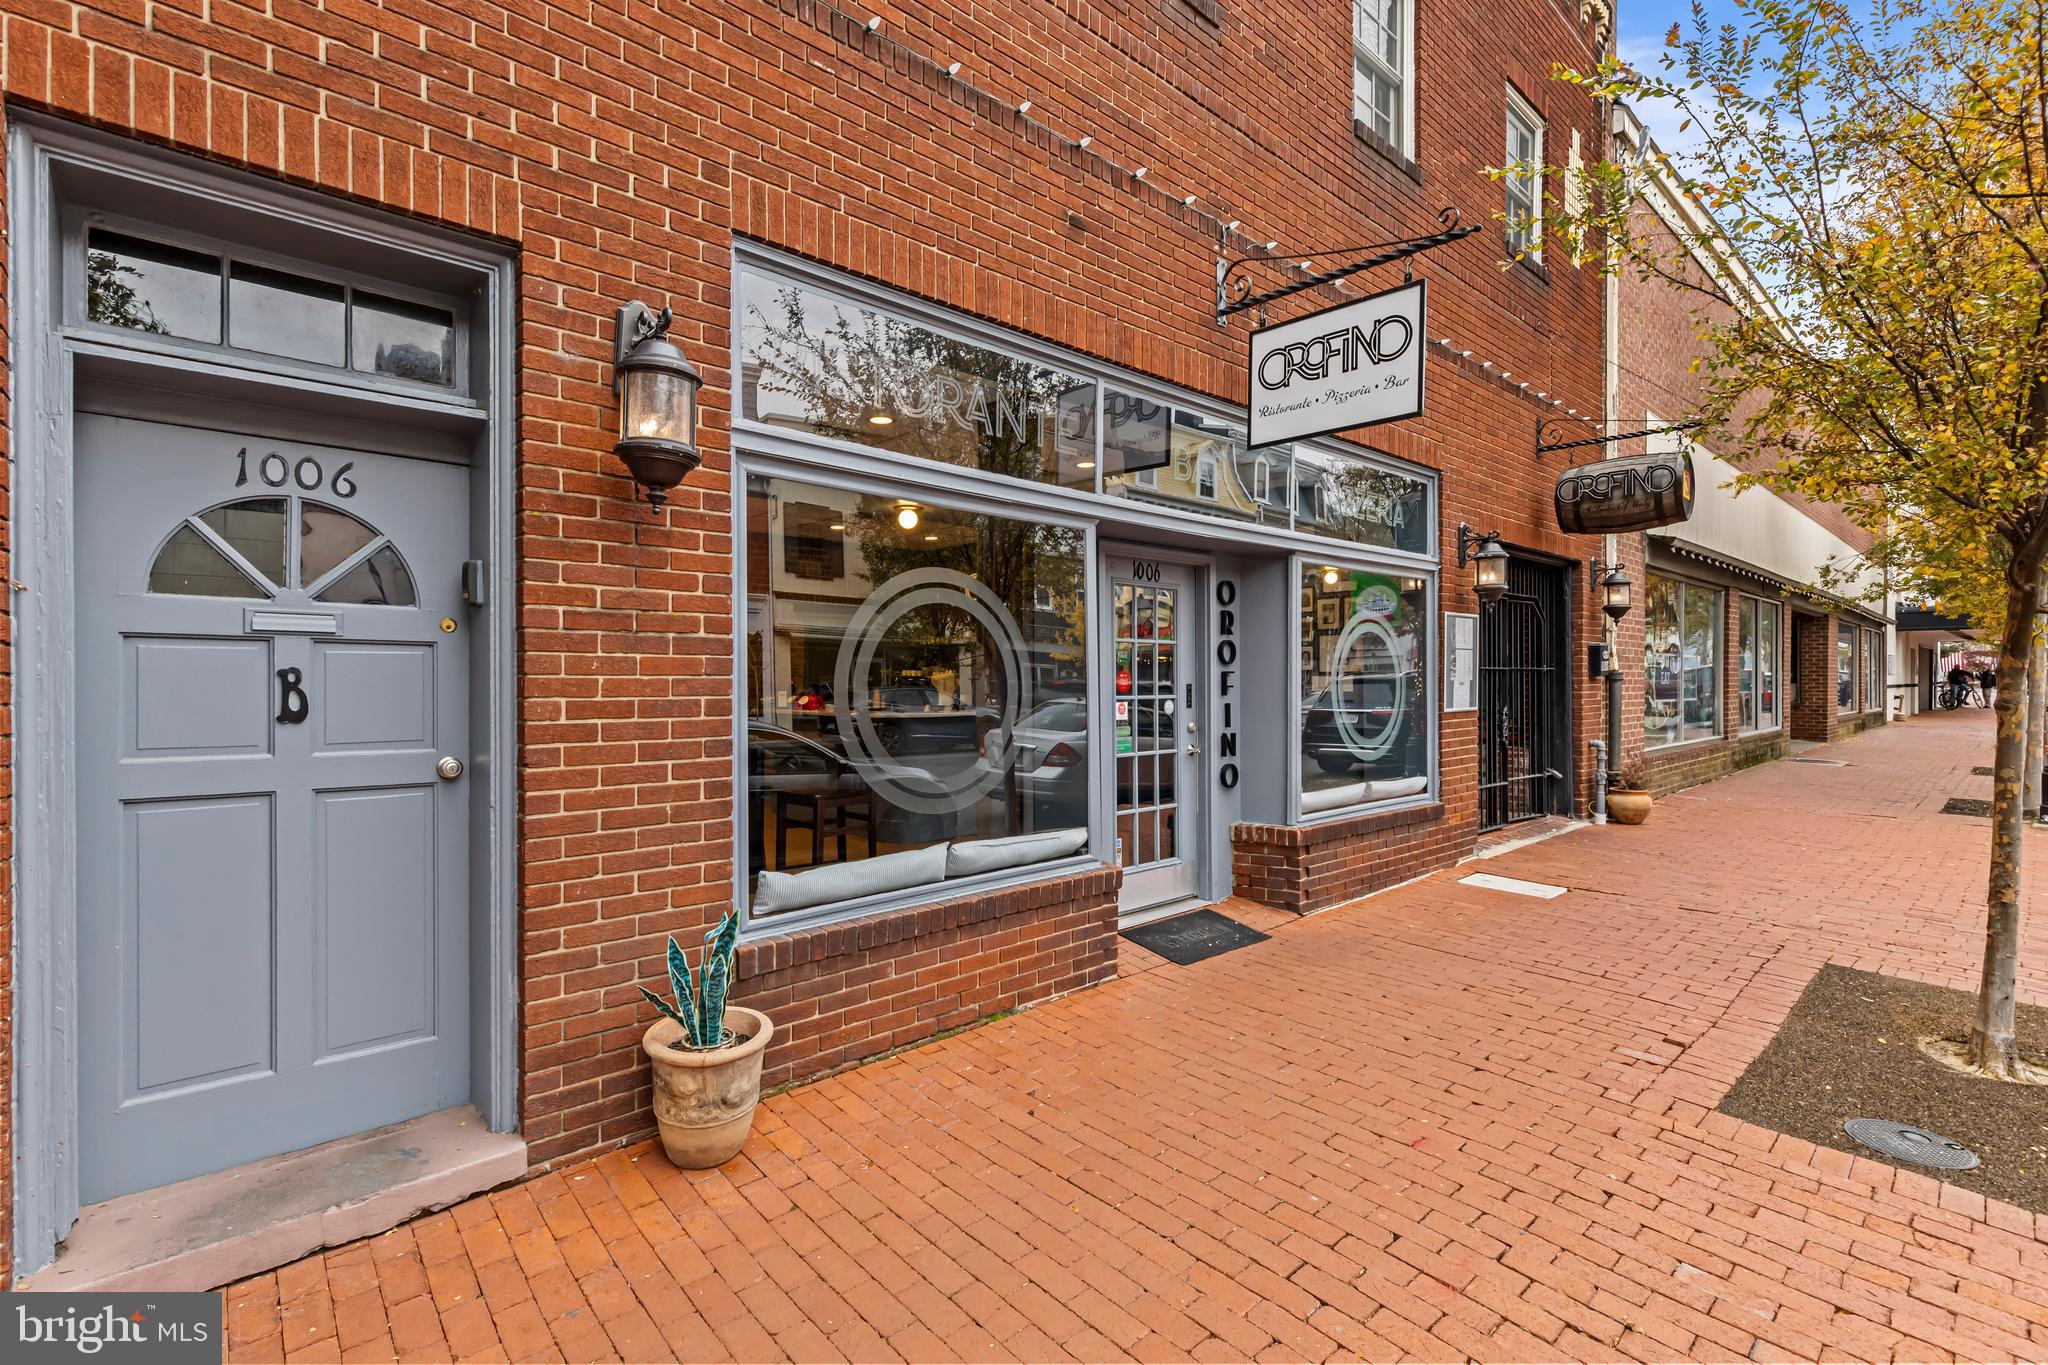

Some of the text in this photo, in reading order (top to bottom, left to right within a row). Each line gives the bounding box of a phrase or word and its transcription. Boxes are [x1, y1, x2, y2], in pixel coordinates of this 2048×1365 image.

[1259, 374, 1410, 419] Ristorante Pizzeria Bar
[235, 447, 357, 499] 1006
[1132, 559, 1160, 582] 1006
[275, 666, 309, 725] B
[1216, 579, 1239, 789] OROFINO
